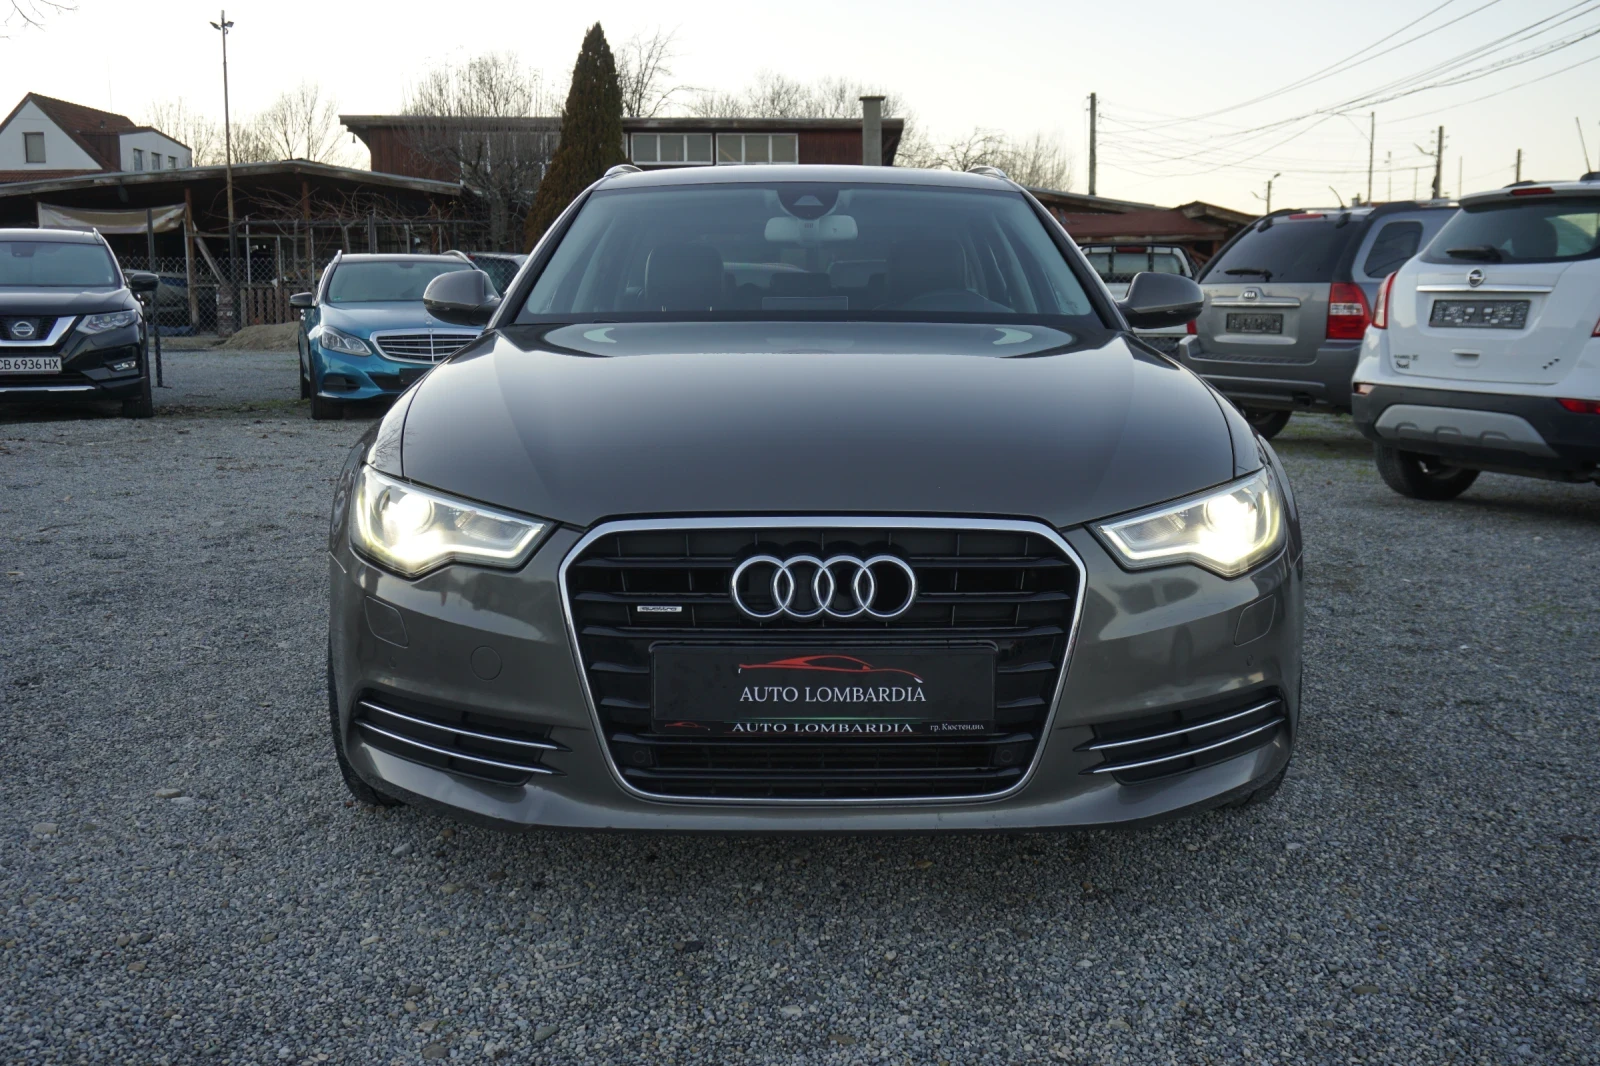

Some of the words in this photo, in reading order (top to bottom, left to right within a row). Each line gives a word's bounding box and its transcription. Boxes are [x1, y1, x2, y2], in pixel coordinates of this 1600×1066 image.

[13, 359, 42, 370] 6936
[43, 359, 59, 370] HX
[739, 686, 799, 702] AUTO
[804, 686, 927, 702] LOMBARDIA
[731, 723, 788, 733] AUTO
[794, 723, 914, 733] LOMBARDIA
